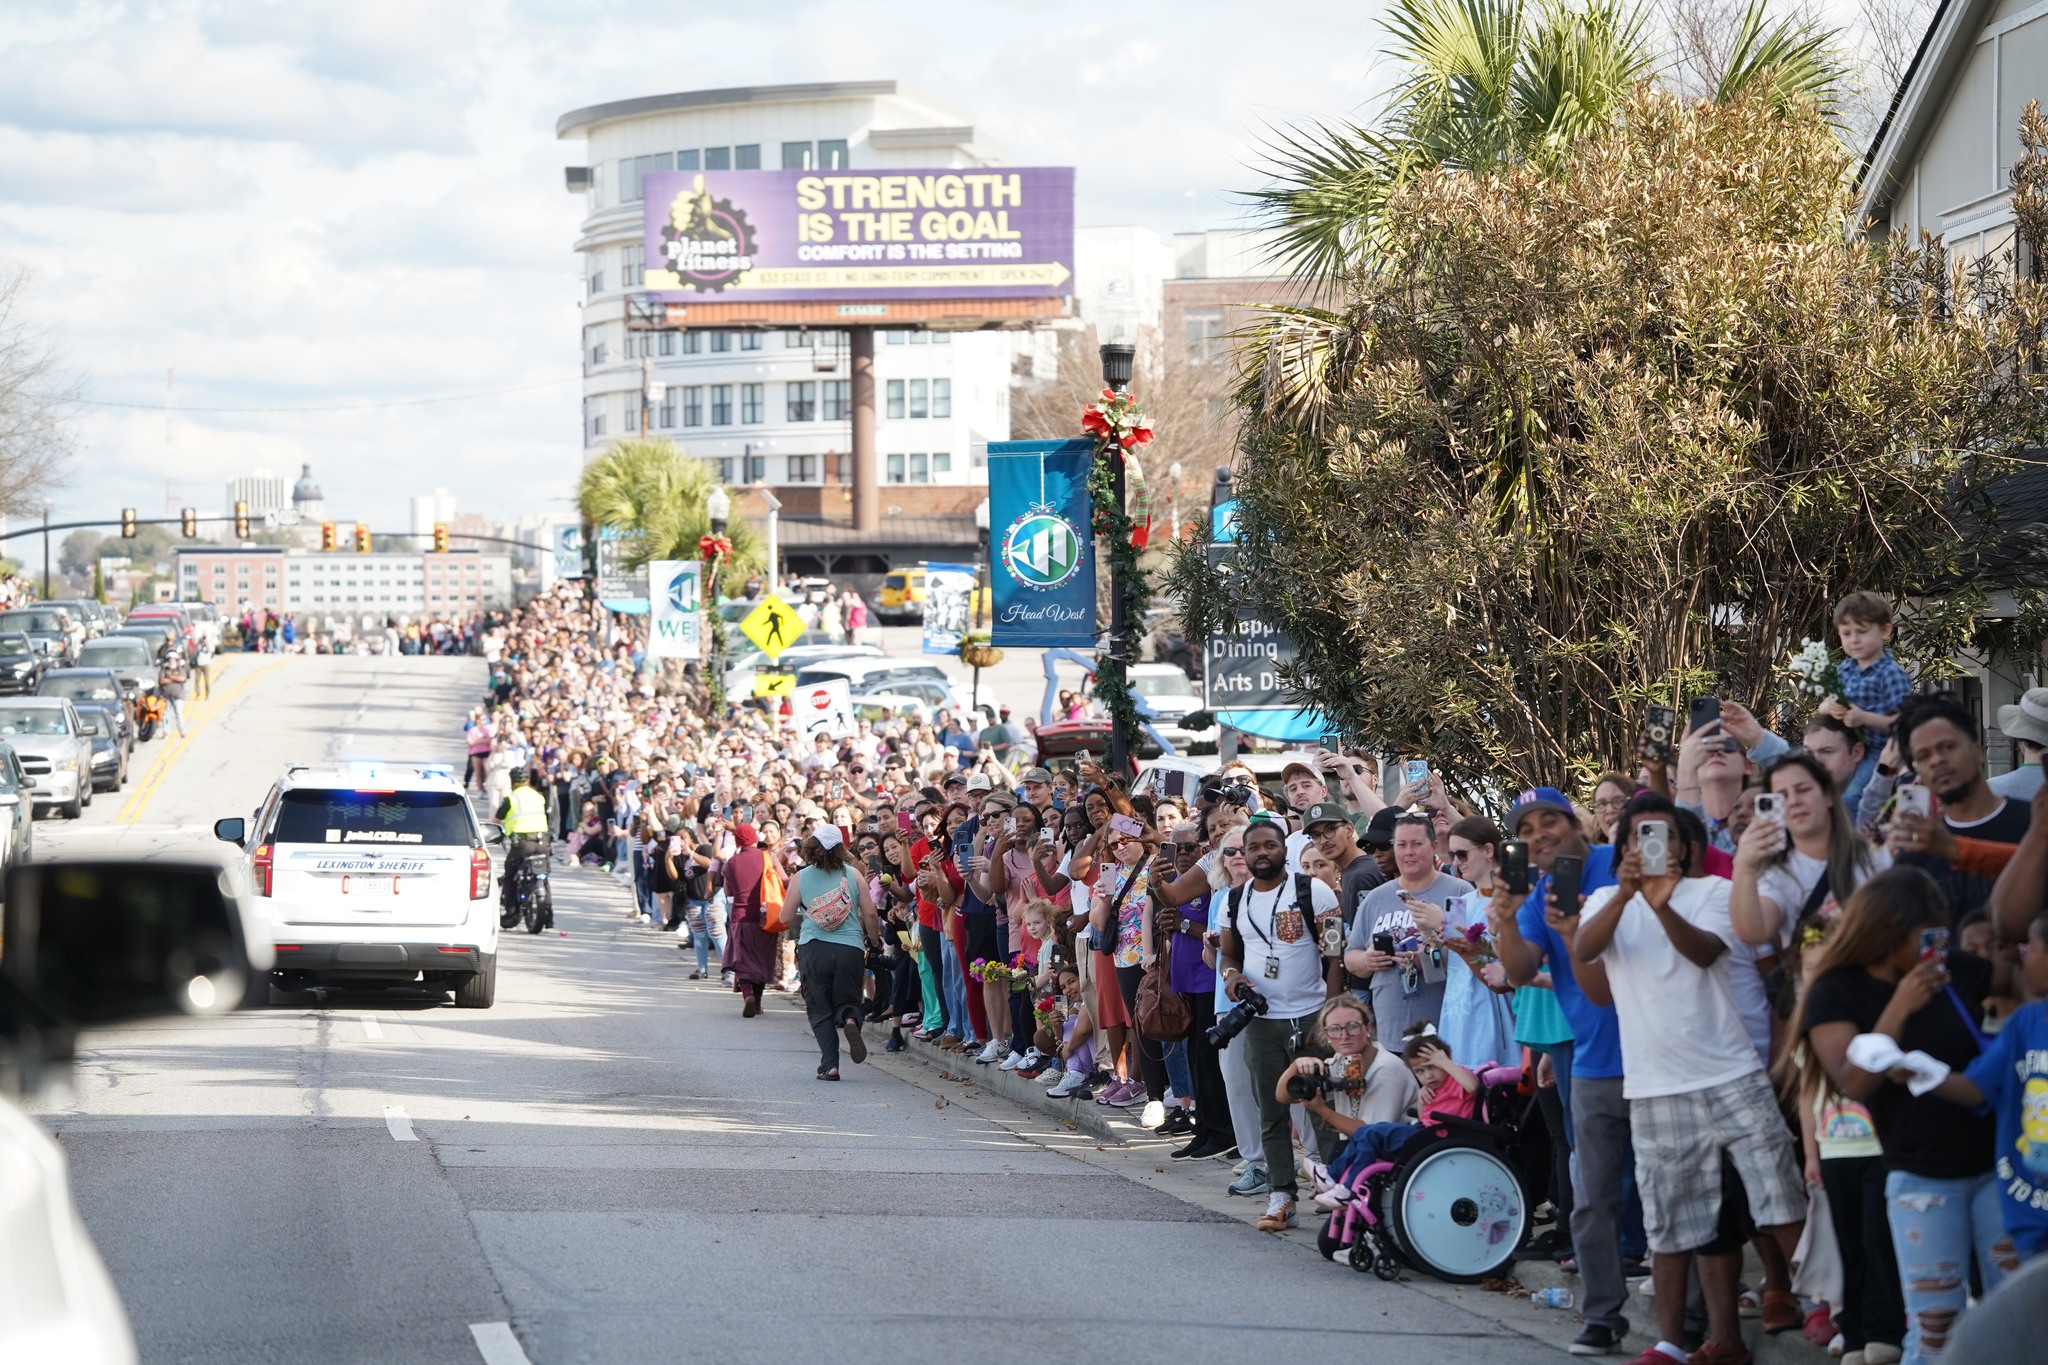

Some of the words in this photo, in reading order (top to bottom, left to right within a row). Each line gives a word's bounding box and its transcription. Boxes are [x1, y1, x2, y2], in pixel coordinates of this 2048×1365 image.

[796, 174, 1021, 210] STRENGTH
[798, 212, 834, 242] IS
[839, 212, 914, 241] THE
[919, 210, 1021, 241] GOAL
[667, 236, 738, 260] planet
[797, 244, 885, 261] COMFORT
[887, 244, 906, 260] IS
[907, 243, 944, 259] THE
[945, 242, 1022, 259] SETTING
[676, 253, 751, 271] fitness
[782, 272, 811, 283] STATE
[845, 272, 859, 282] NO
[862, 270, 917, 282] LONG-TERM
[921, 269, 985, 281] COMMITMENT
[1000, 269, 1026, 280] OPEN
[1000, 603, 1044, 623] Head
[1045, 603, 1085, 622] West
[658, 619, 691, 638] WE
[1213, 639, 1278, 663] Dining
[1213, 672, 1253, 692] Arts
[811, 692, 831, 707] STOP
[316, 860, 375, 870] LEXINGTON
[377, 861, 426, 871] SHERIFF
[2007, 1176, 2032, 1202] TO
